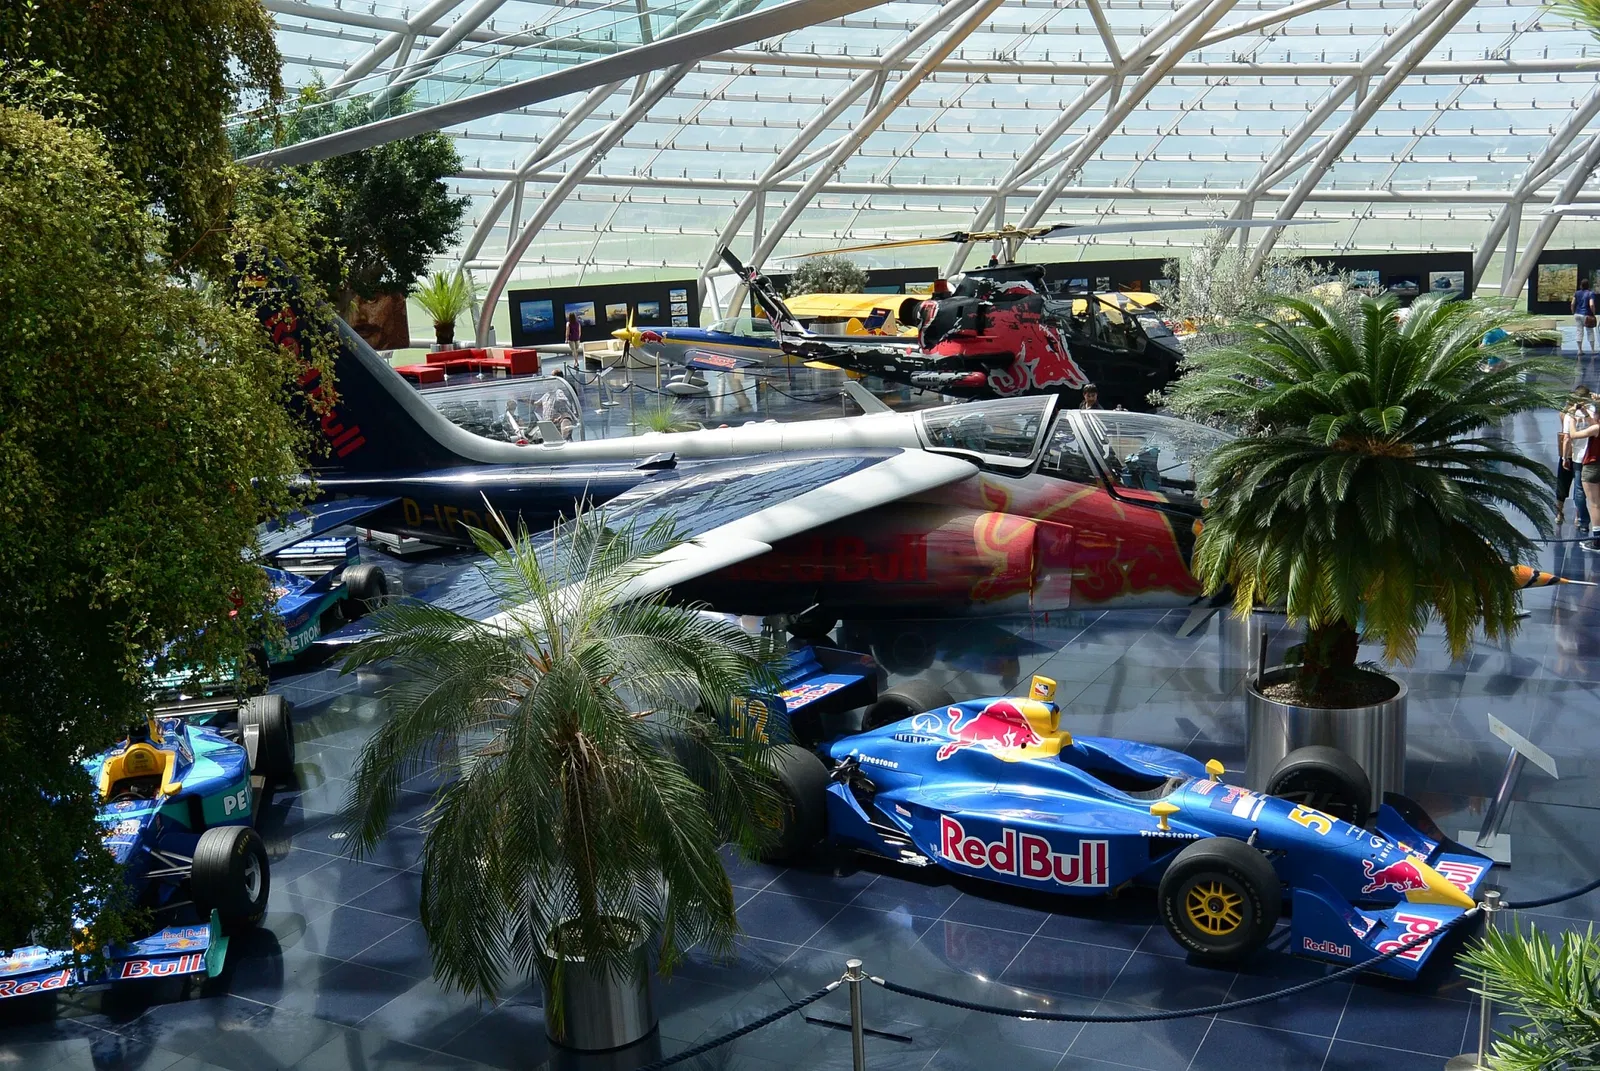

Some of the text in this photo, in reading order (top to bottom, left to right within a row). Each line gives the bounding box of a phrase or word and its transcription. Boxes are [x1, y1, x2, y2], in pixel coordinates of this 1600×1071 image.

[859, 753, 899, 769] Firestone
[1139, 829, 1200, 840] Firestone
[941, 814, 1109, 888] Red Bull
[1303, 936, 1352, 958] Red Bull
[0, 952, 203, 999] Red Bull
